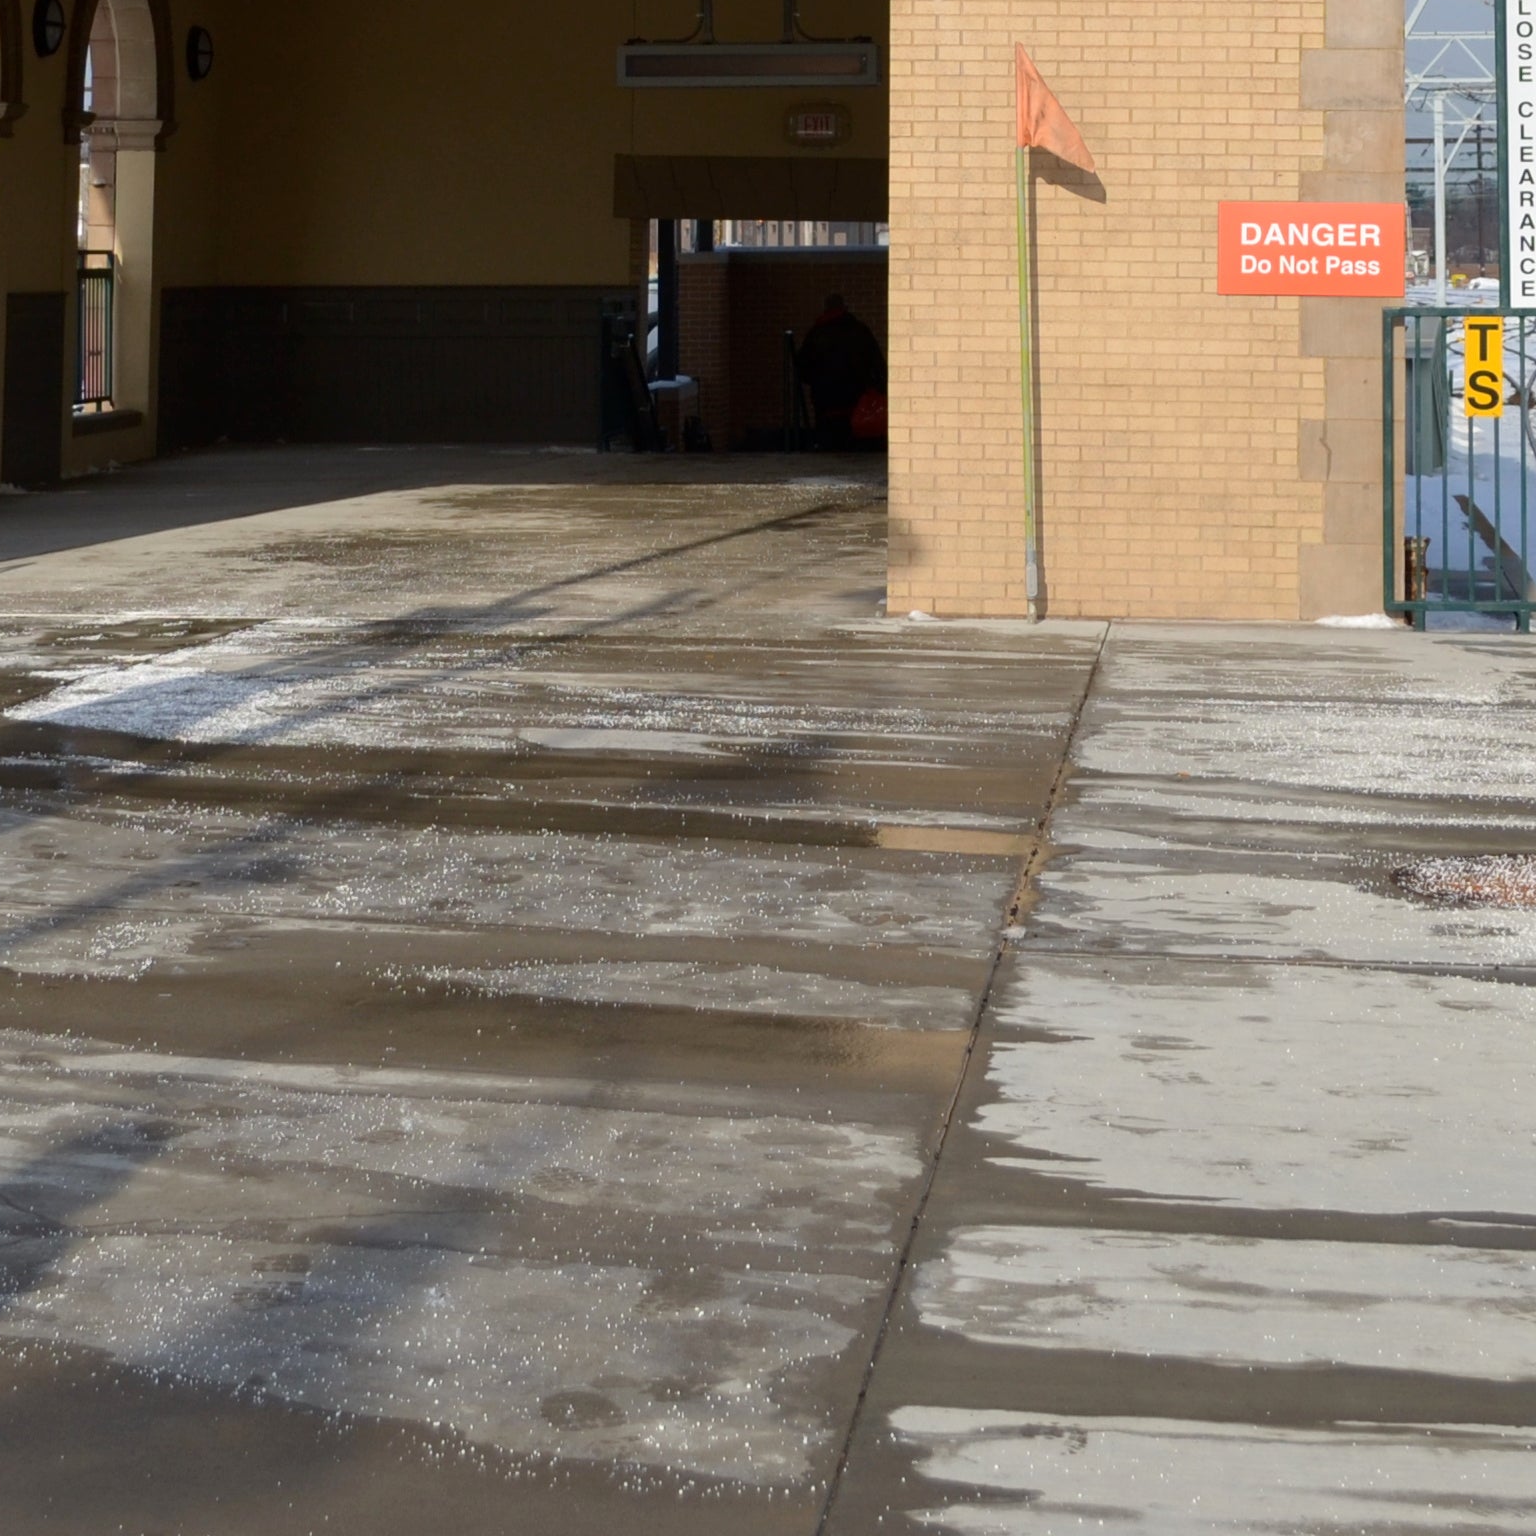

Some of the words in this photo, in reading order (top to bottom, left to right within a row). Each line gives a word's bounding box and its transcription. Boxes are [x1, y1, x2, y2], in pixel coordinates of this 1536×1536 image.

[1518, 101, 1536, 297] CLEARANCE
[1240, 222, 1381, 247] DANGER
[1241, 255, 1272, 274] Do
[1279, 255, 1319, 274] Not
[1326, 256, 1381, 276] Pass
